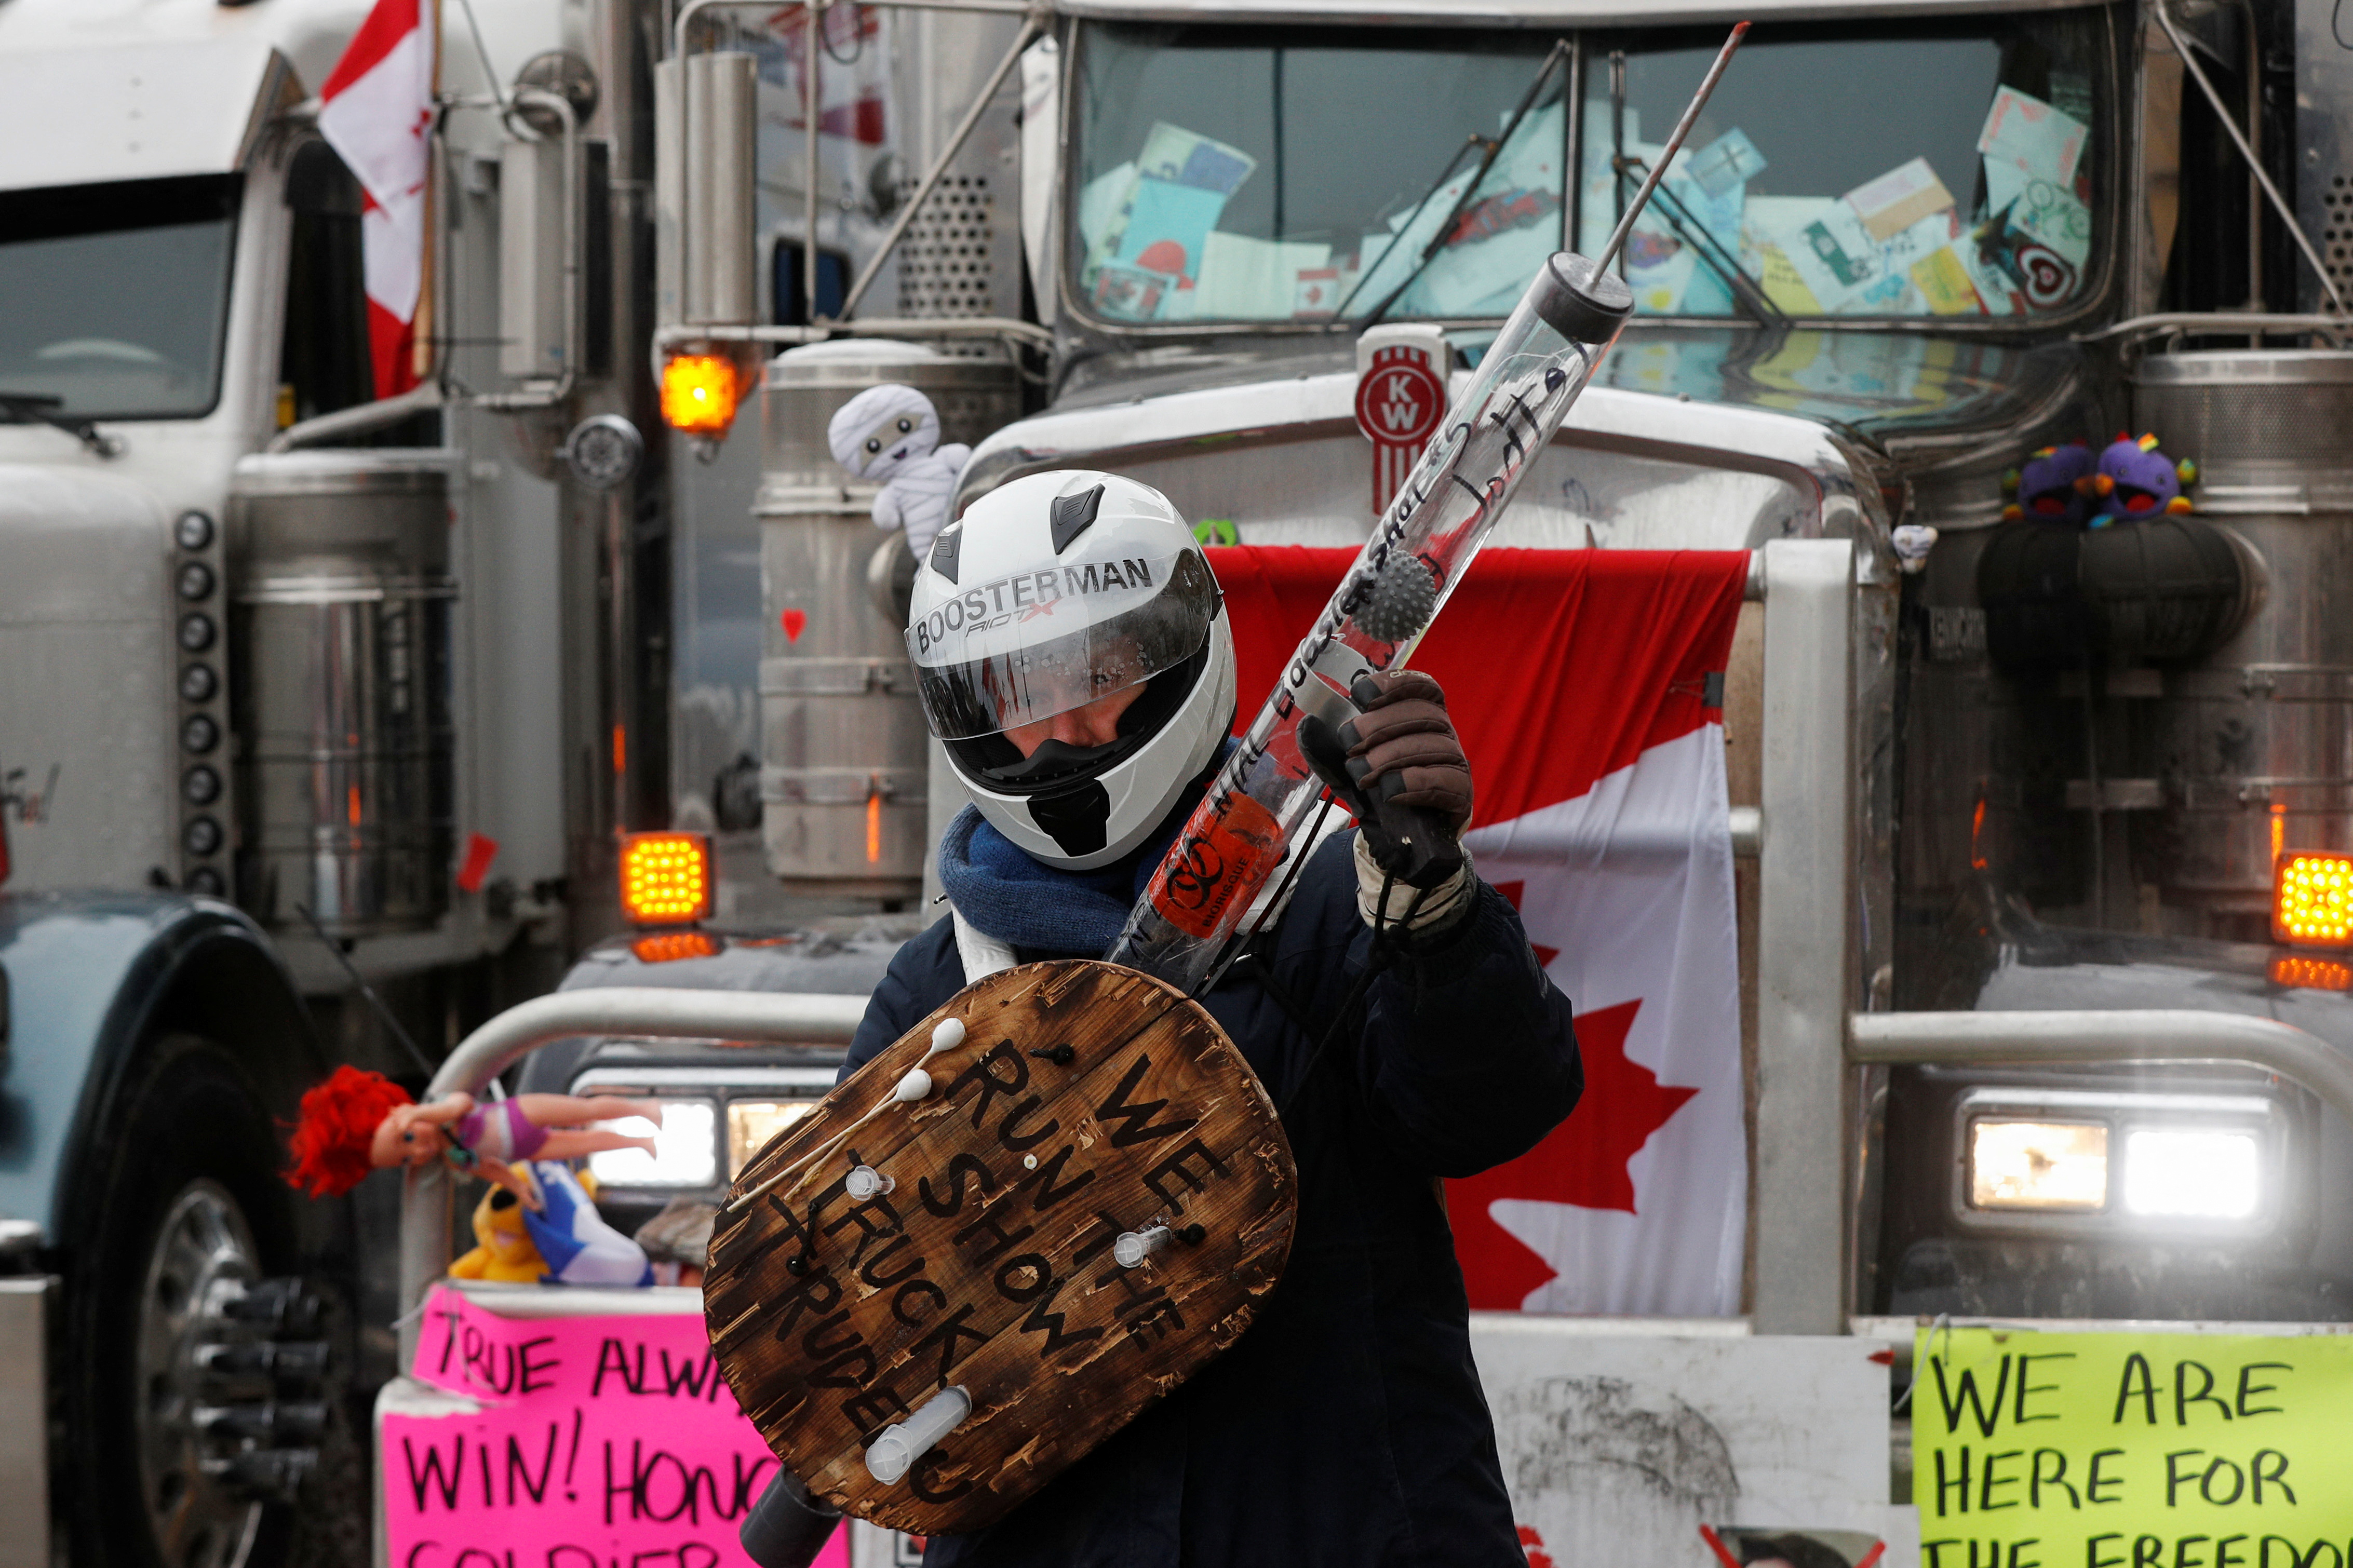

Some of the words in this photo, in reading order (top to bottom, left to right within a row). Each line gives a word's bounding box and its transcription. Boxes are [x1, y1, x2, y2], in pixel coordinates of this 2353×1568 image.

[1381, 403, 1419, 430] W
[1388, 375, 1413, 403] K
[1201, 855, 1251, 928] BIORISQUE
[1096, 1052, 1233, 1218] WE
[945, 1038, 1097, 1211] RUN
[1072, 1210, 1186, 1353] THE
[808, 1148, 989, 1389] TRUCK
[917, 1153, 1104, 1359] SHOW
[433, 1310, 561, 1395] TRUE
[733, 1193, 974, 1504] TRUDEU
[1931, 1352, 2077, 1438] WE
[2113, 1351, 2294, 1426] ARE
[1934, 1446, 2126, 1517] HERE
[2166, 1448, 2297, 1509] FOR
